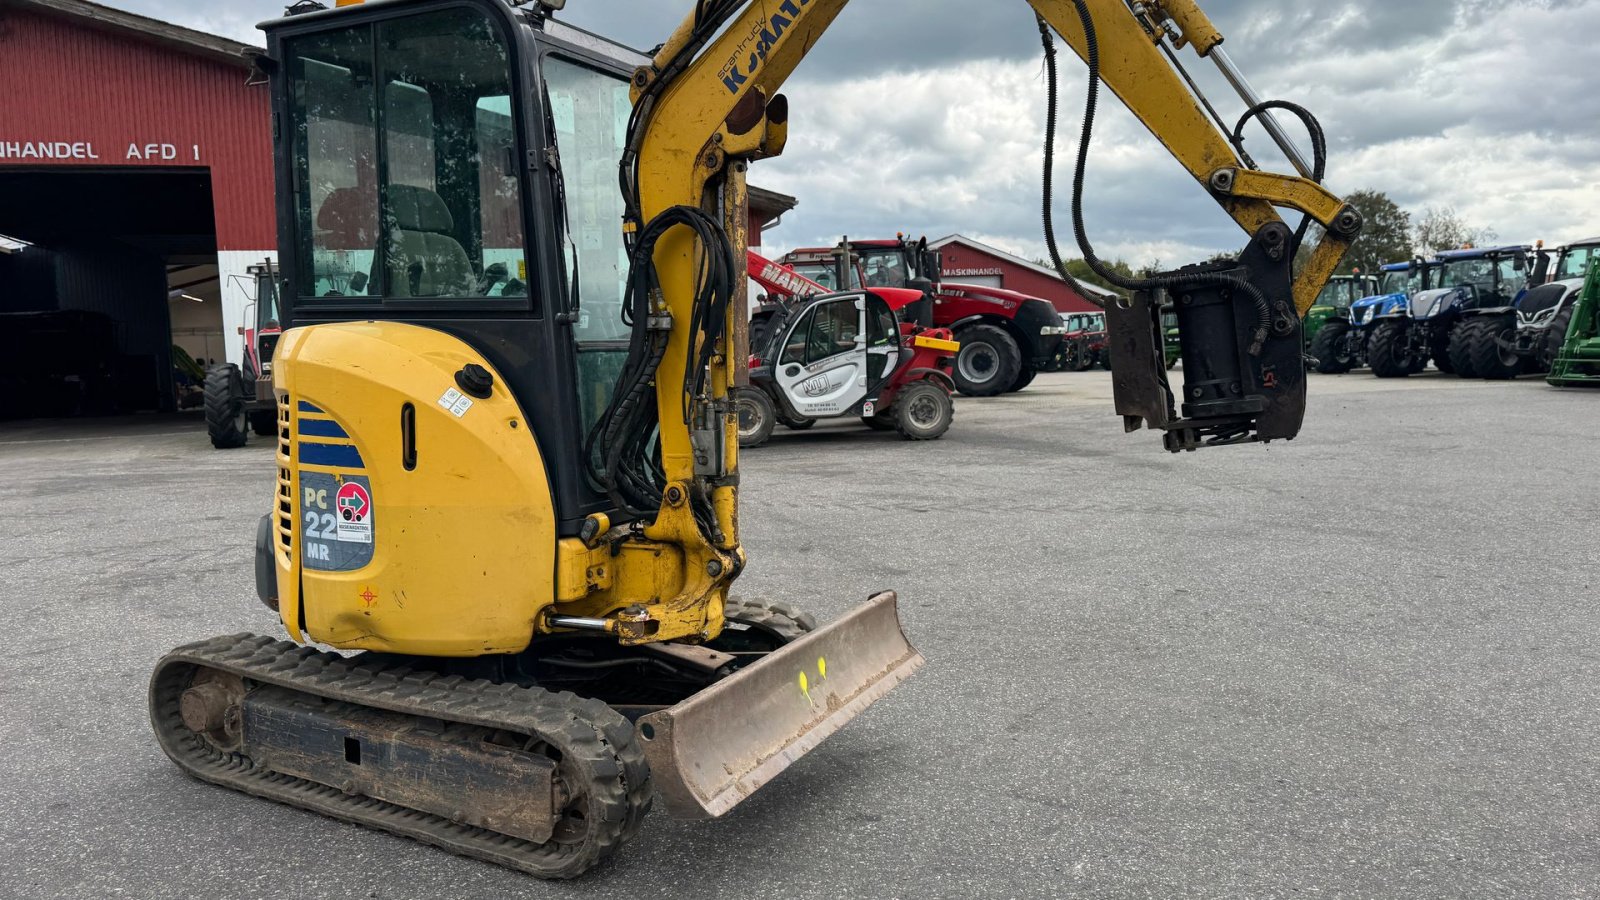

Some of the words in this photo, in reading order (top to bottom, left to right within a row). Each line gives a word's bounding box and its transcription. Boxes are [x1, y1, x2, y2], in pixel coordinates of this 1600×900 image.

[717, 19, 766, 80] scantruck
[723, 0, 809, 94] KOMAT
[126, 143, 177, 159] AFD
[193, 145, 200, 160] 1
[943, 267, 1003, 276] MASKINHANDEL
[305, 487, 327, 509] PC
[306, 511, 337, 540] 22
[307, 542, 330, 561] MR
